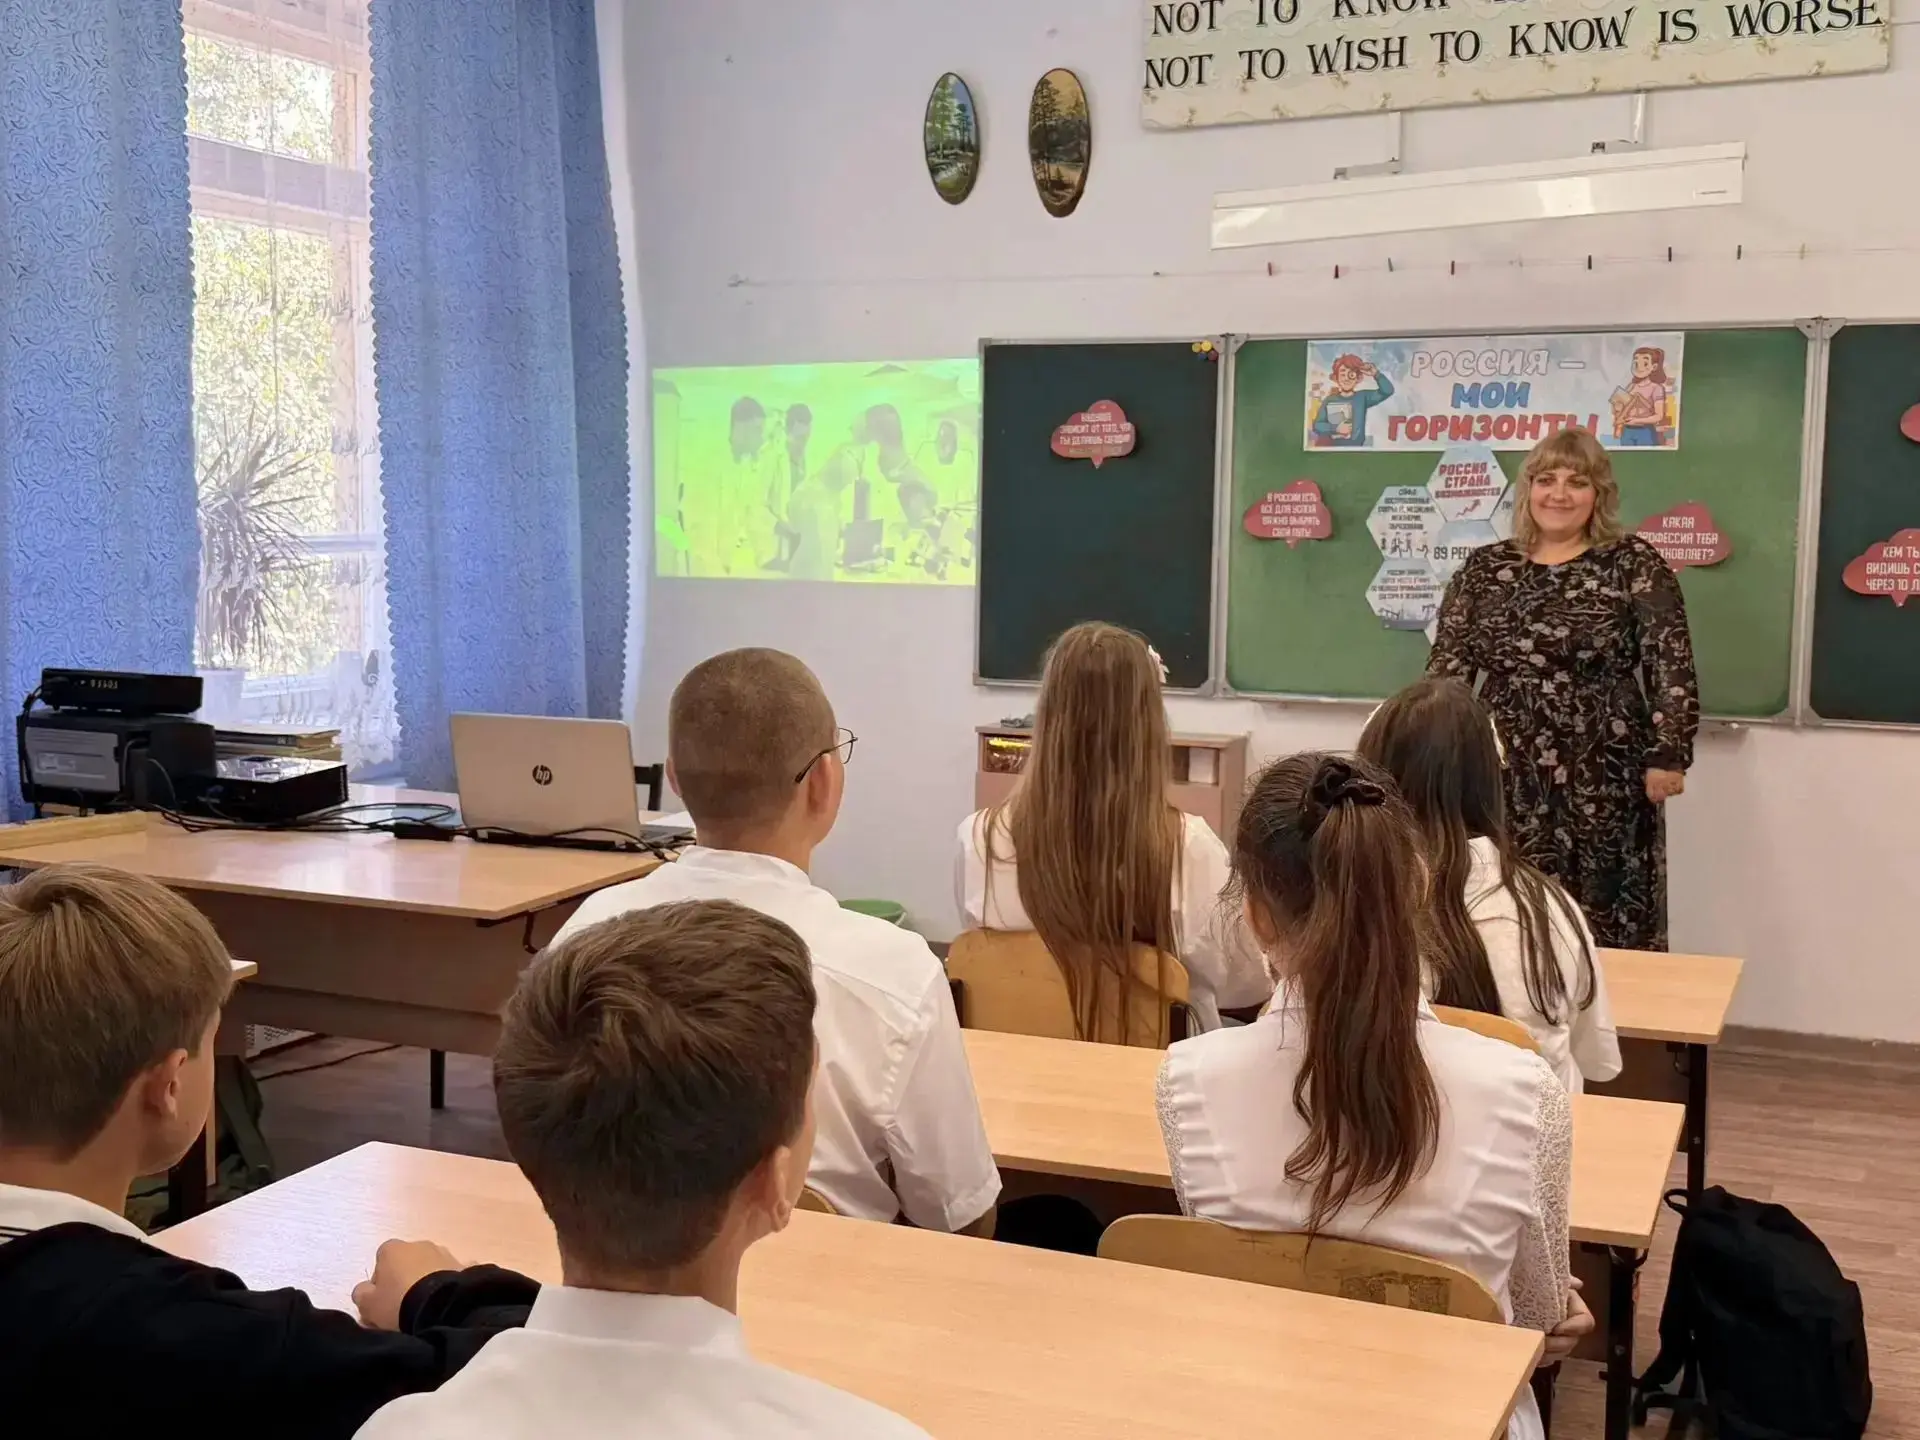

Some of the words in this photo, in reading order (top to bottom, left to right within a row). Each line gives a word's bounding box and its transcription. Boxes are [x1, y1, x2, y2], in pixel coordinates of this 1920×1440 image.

[1152, 0, 1223, 36] NOT
[1250, 0, 1299, 28] TO
[1144, 54, 1213, 89] NOT
[1239, 48, 1286, 82] TO
[1307, 35, 1408, 76] WISH
[1430, 30, 1481, 65] TO
[1509, 6, 1636, 57] KNOW
[1658, 9, 1699, 45] IS
[1725, 0, 1884, 38] WORSE
[1410, 349, 1551, 378] РОССИЯ
[1451, 381, 1531, 409] МОИ
[1438, 462, 1488, 476] РОССИЯ
[1444, 474, 1491, 489] СТРАНА
[1662, 516, 1695, 528] КАКАЯ
[1696, 532, 1719, 545] ТЕБЯ
[1434, 546, 1448, 560] 89
[1882, 546, 1903, 558] КЕМ
[1866, 562, 1910, 575] ВИДИШЬ
[1866, 578, 1895, 591] ЧЕРЕЗ
[1897, 578, 1908, 591] 10
[532, 764, 553, 786] hp
